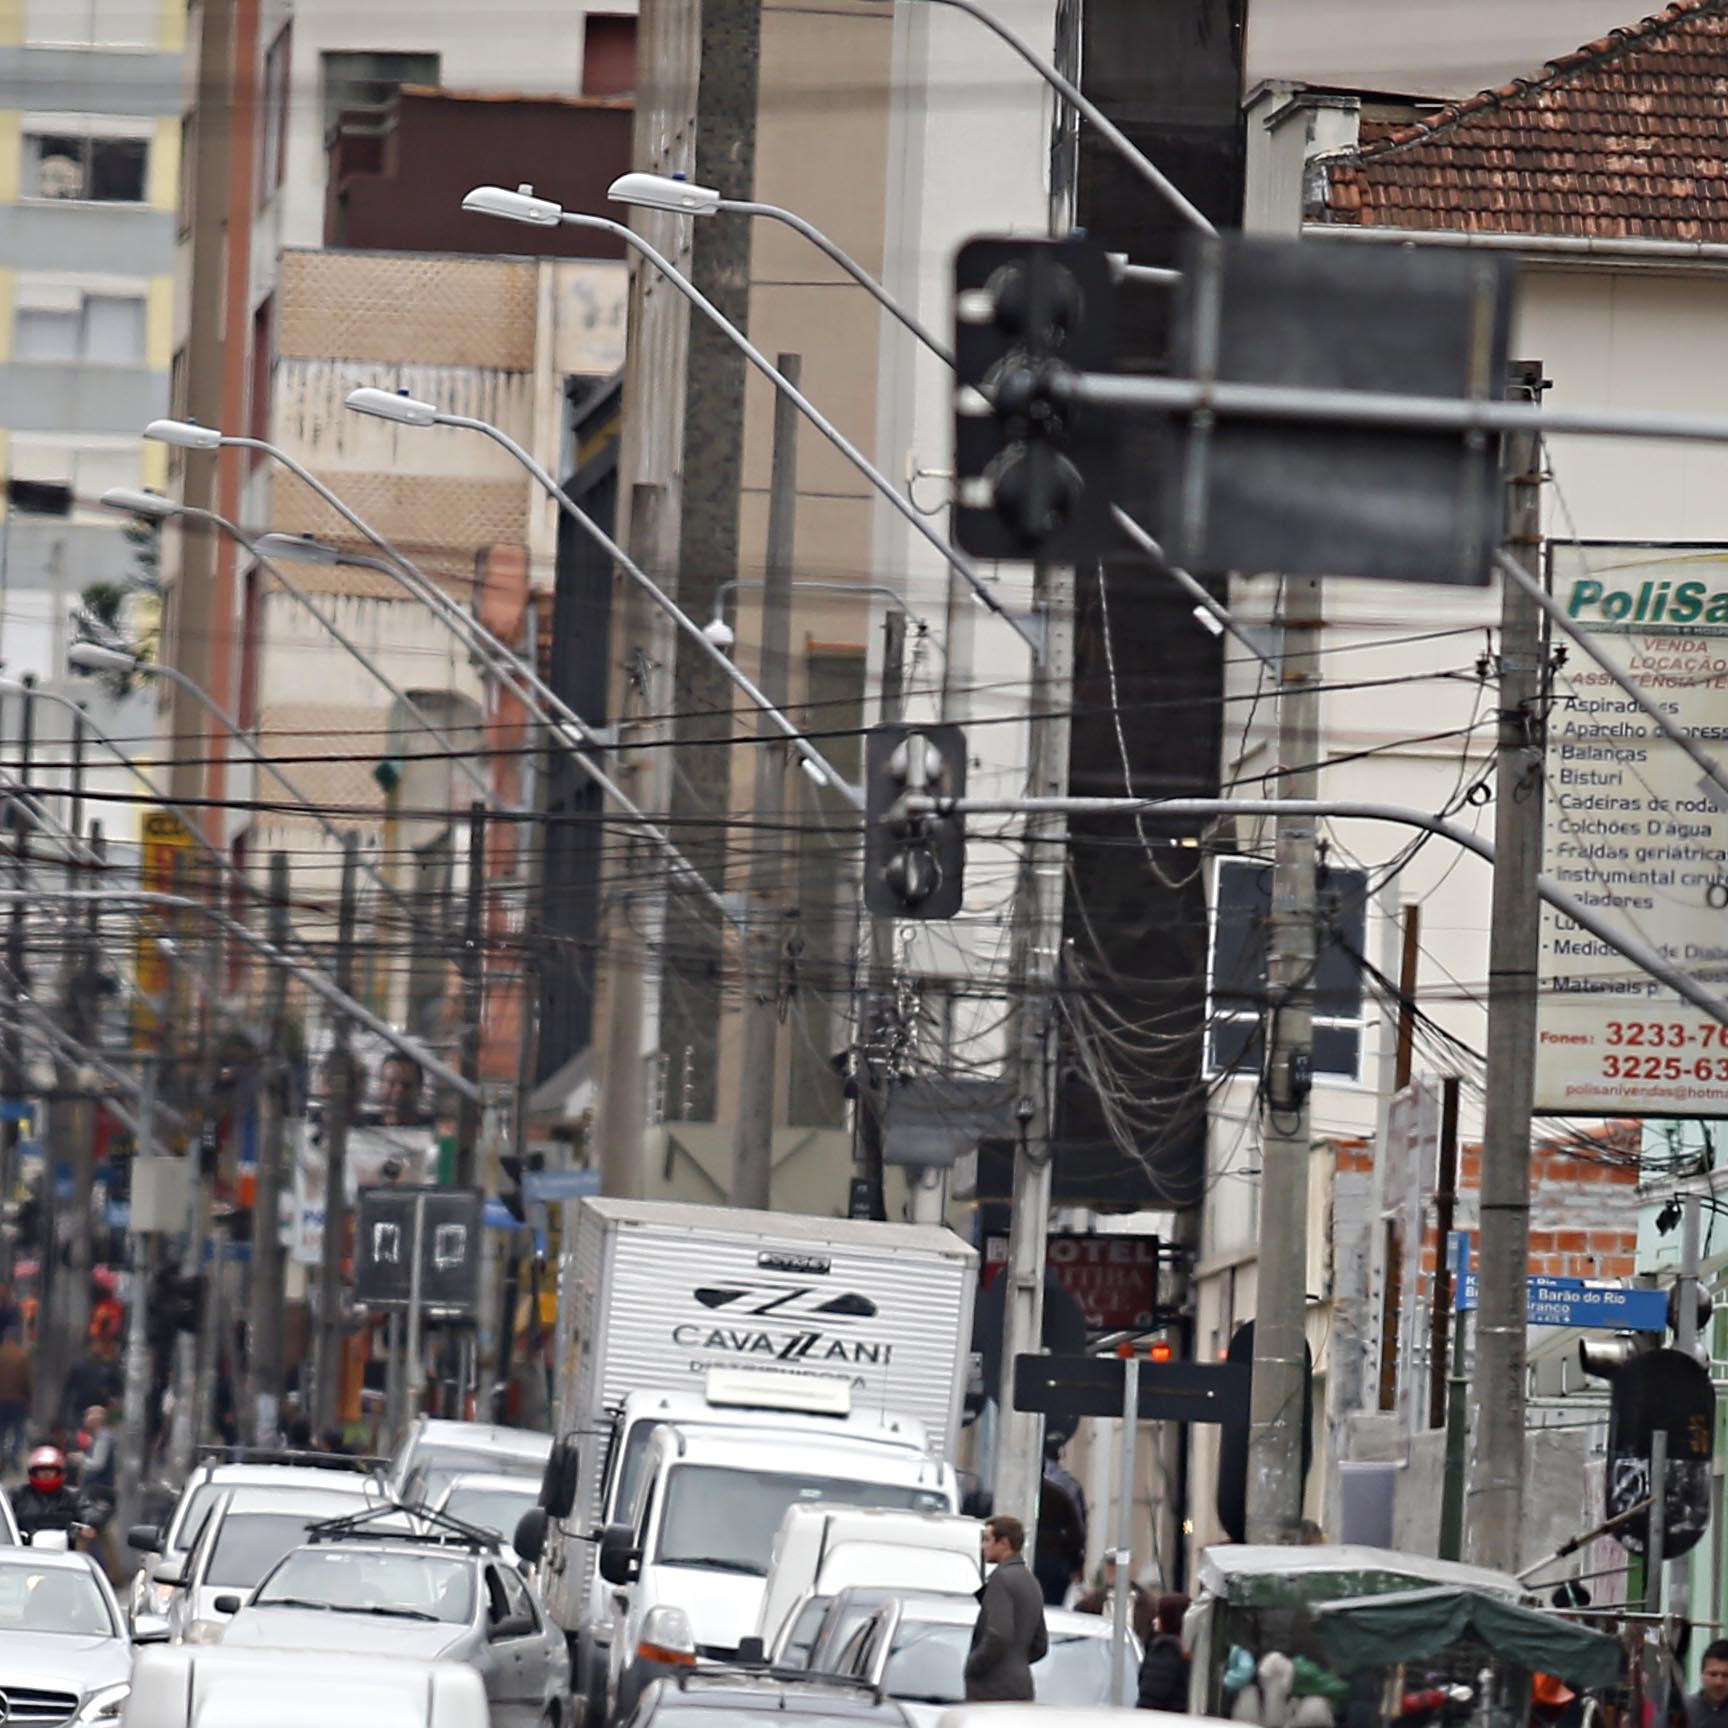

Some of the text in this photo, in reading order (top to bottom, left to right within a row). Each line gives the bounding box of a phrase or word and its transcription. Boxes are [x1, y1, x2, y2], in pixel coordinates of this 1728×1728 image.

[1644, 638, 1708, 653] VENDA
[1630, 656, 1727, 673] LOCAÇÃO
[1572, 671, 1699, 688] ASSIÊNCIA
[1564, 722, 1647, 740] Aparelho
[1561, 746, 1647, 764] Balanças
[1560, 768, 1622, 785] Bisturi
[1559, 793, 1641, 810] Cadeiras
[1648, 797, 1669, 811] de
[1557, 843, 1629, 859] Fraldas
[1539, 1031, 1594, 1045] Fones:
[1049, 1239, 1153, 1263] OTEL
[1538, 1287, 1580, 1303] Barão
[1583, 1291, 1600, 1304] do
[1603, 1291, 1626, 1305] Rio
[672, 1324, 892, 1364] CAVAZZANI
